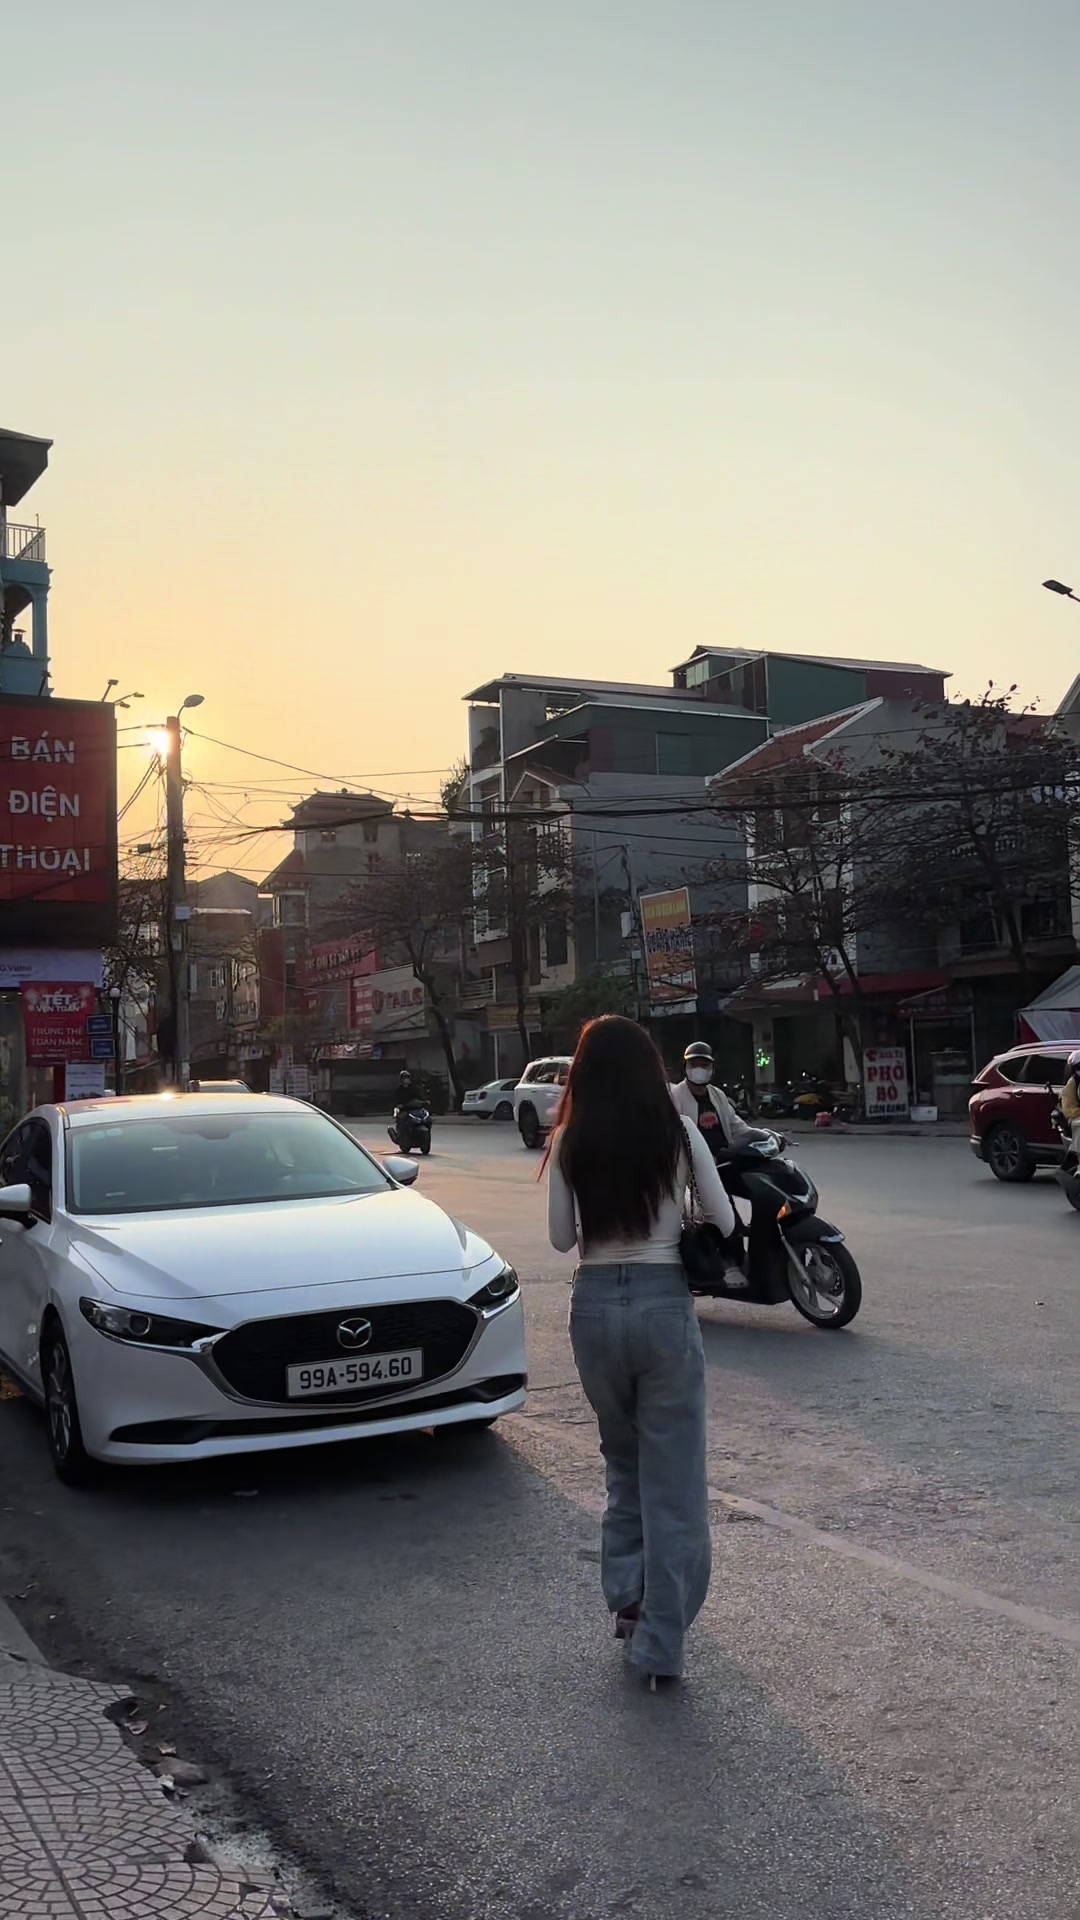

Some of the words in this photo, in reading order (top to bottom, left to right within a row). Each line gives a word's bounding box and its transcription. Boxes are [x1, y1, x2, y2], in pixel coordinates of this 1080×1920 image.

[11, 730, 75, 764] BÁN
[8, 784, 80, 822] ĐIỆN
[0, 845, 90, 877] THOẠI
[42, 988, 73, 1006] TẾT
[866, 1060, 905, 1083] PHỞ
[300, 1356, 412, 1389] 99A-594.60
